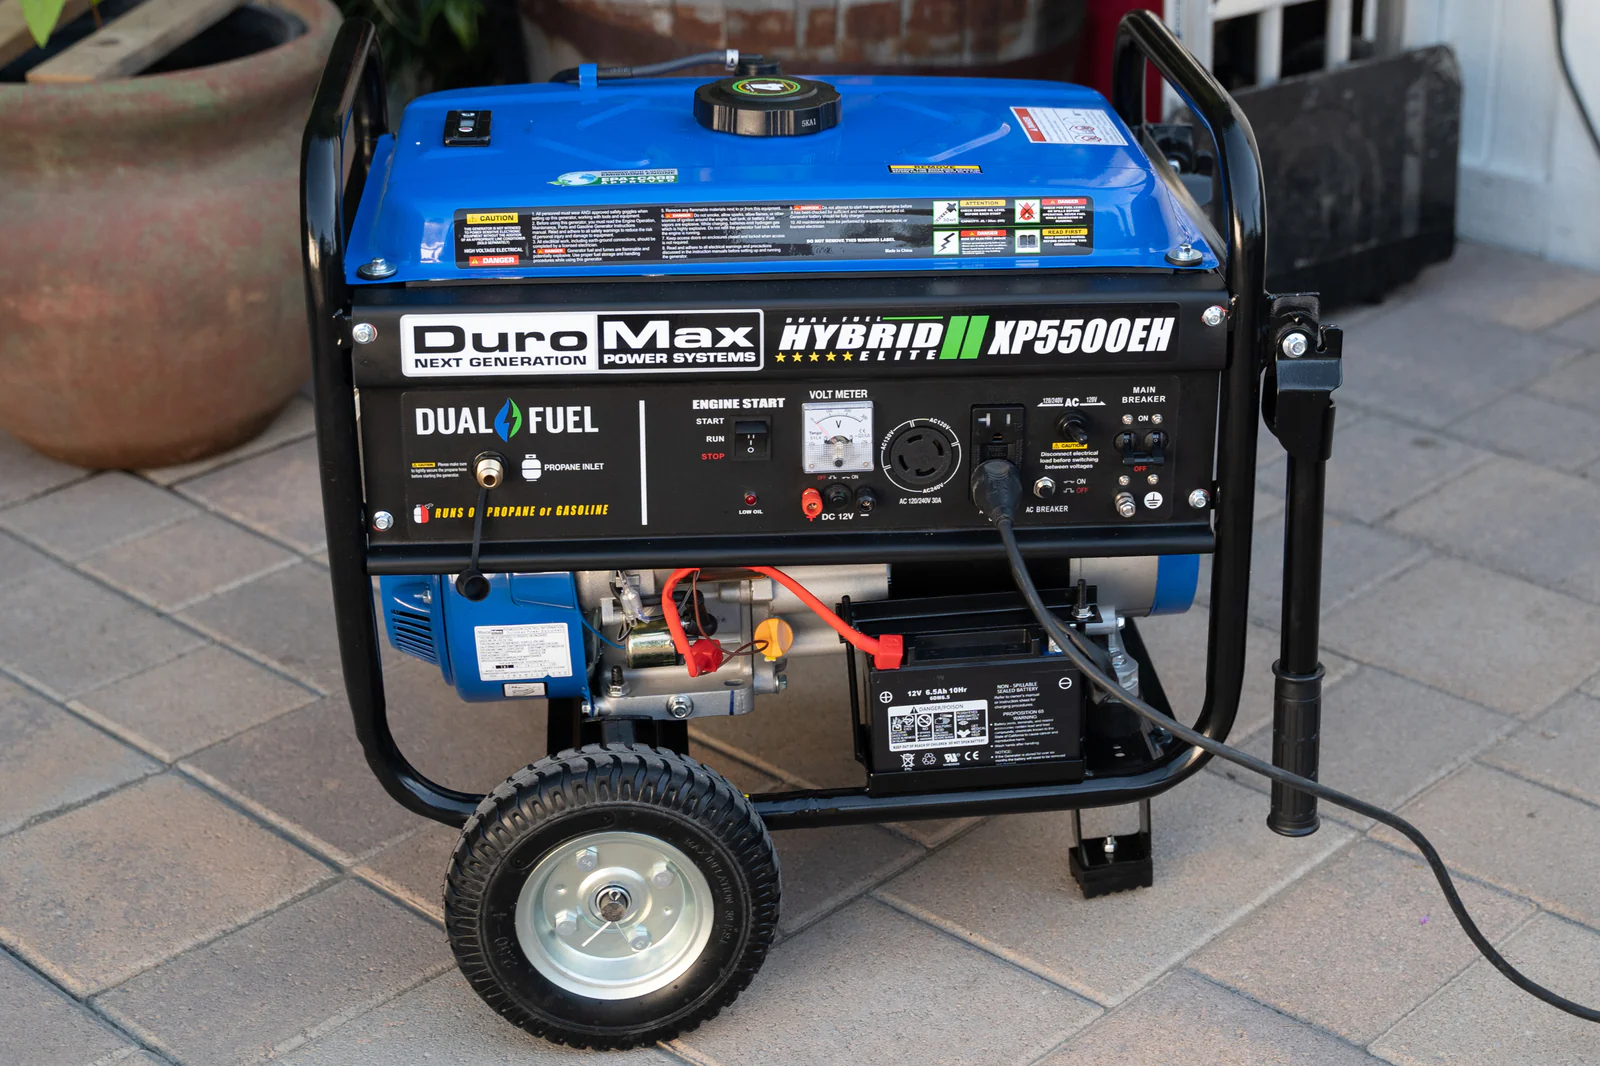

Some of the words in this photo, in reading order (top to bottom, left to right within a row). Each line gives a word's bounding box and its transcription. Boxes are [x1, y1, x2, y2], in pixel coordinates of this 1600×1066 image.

[802, 118, 816, 127] 5KA1
[413, 325, 588, 354] Duro
[603, 320, 754, 349] Max
[778, 322, 944, 351] HYBRID
[987, 318, 1175, 355] XP5500EH
[604, 352, 668, 364] POWER
[673, 352, 755, 363] SYSTEMS
[859, 349, 937, 361] ELITE
[415, 357, 463, 368] NEXT
[470, 356, 586, 367] GENERATION
[809, 390, 832, 399] VOLT
[835, 389, 868, 399] METER
[692, 398, 740, 410] ENGINE
[742, 398, 785, 408] START
[1065, 398, 1080, 407] AC
[415, 407, 493, 435] DUAL
[528, 406, 599, 434] FUEL
[836, 420, 841, 428] V
[929, 418, 950, 430] AC120V
[880, 430, 895, 451] AC120V
[922, 482, 944, 494] AC240V
[434, 508, 463, 518] RUNS
[487, 506, 536, 517] PROPANE
[539, 506, 553, 516] or
[556, 504, 609, 515] GASOLINE
[705, 854, 734, 904] INFLATION
